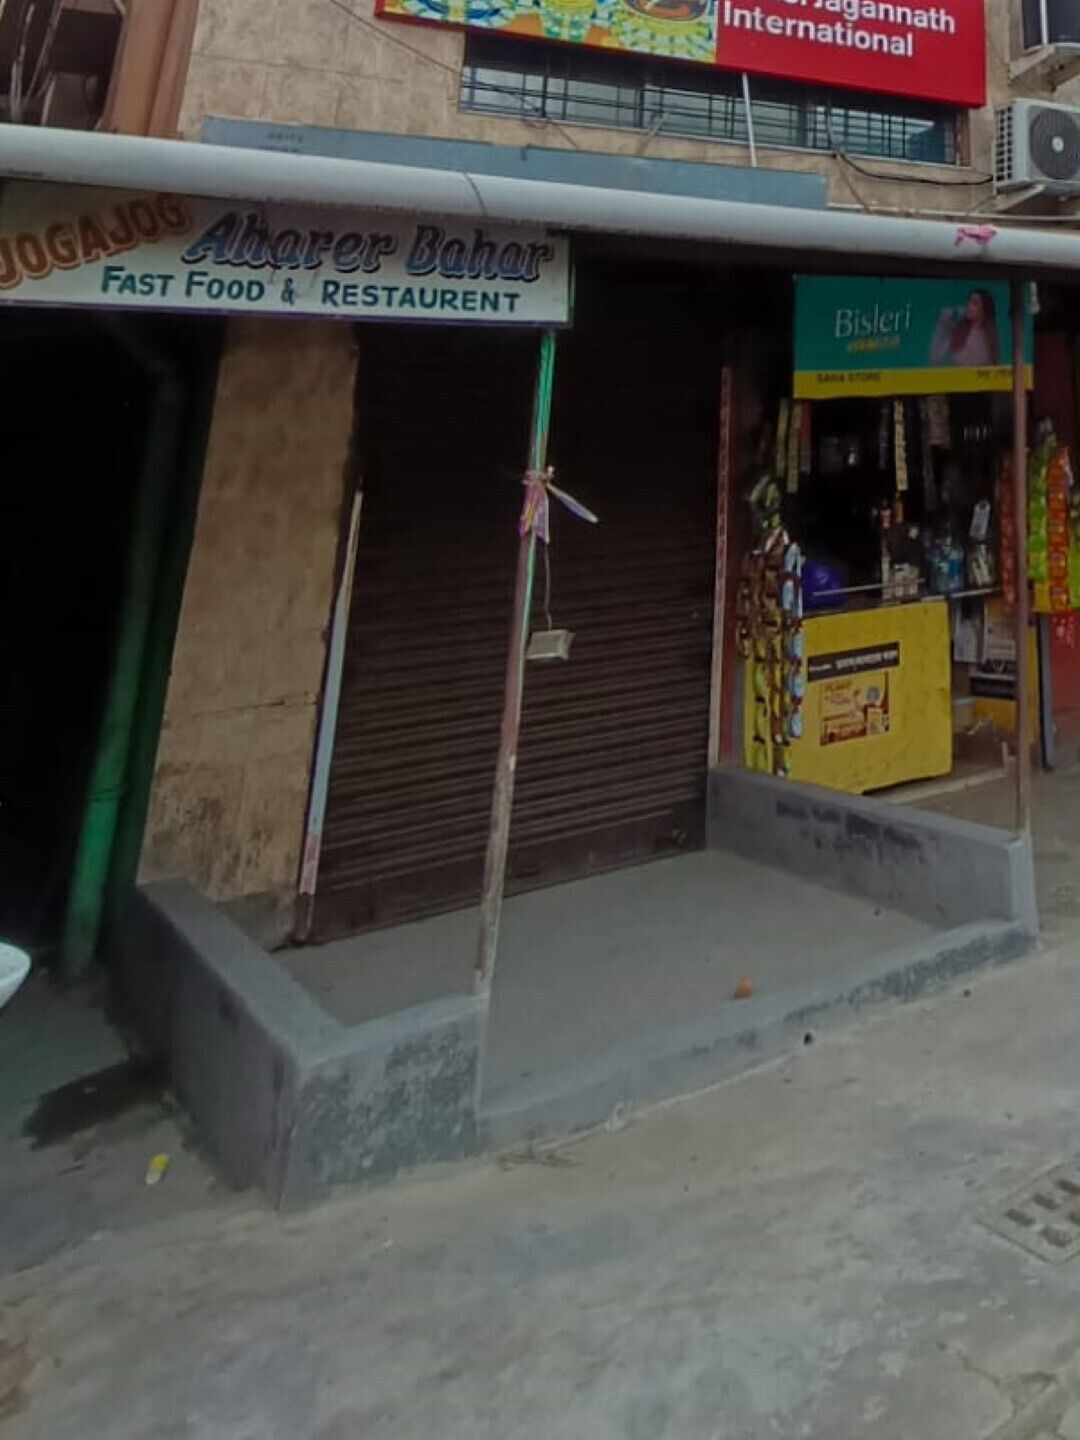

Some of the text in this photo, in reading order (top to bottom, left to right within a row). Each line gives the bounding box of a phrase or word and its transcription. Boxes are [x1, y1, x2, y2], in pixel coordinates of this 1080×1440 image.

[0, 191, 190, 288] JOGAJOG
[180, 211, 552, 284] Aharer Bahar
[100, 265, 521, 313] FAST FOOD & RESTAURENT
[834, 303, 912, 339] Bisleri
